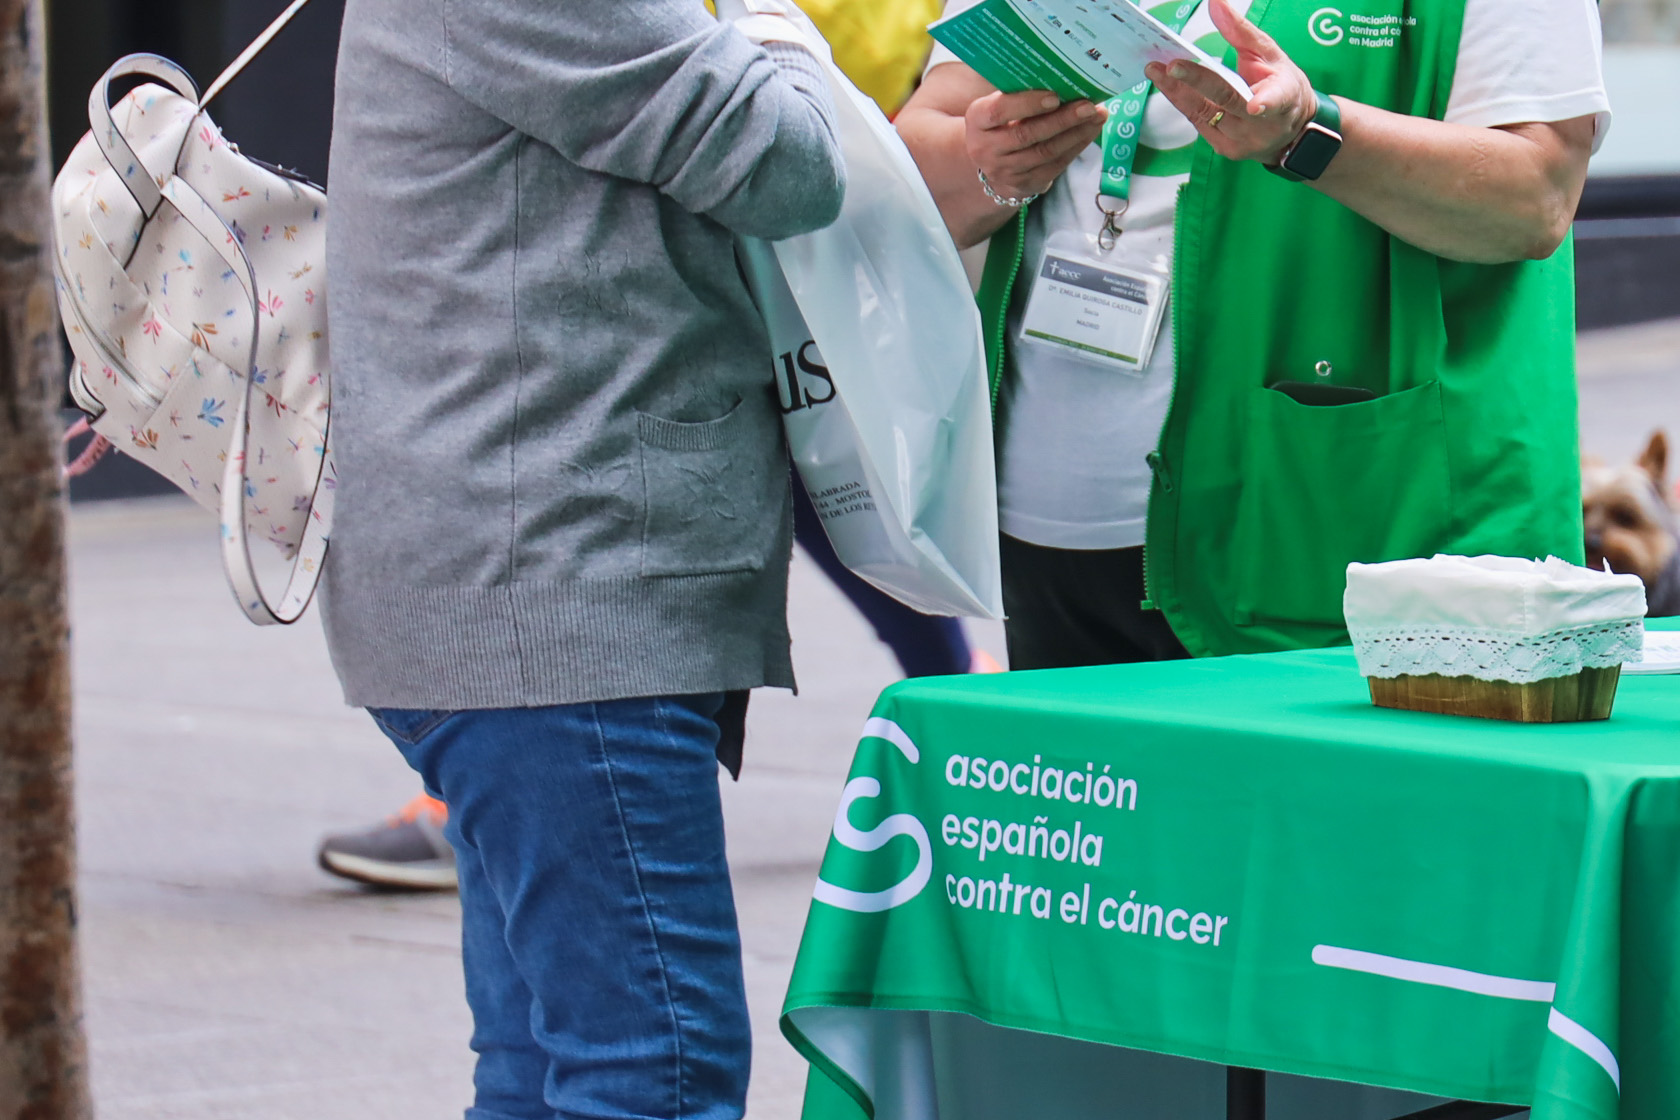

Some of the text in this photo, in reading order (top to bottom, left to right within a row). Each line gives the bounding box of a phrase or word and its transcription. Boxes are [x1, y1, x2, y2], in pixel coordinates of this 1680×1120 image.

[1350, 14, 1398, 24] asociación
[1350, 25, 1379, 36] contra
[1380, 25, 1388, 35] el
[1349, 37, 1394, 47] en Madrid
[945, 753, 1138, 811] asociación
[941, 813, 1103, 867] española
[945, 872, 1229, 947] contra el cáncer
